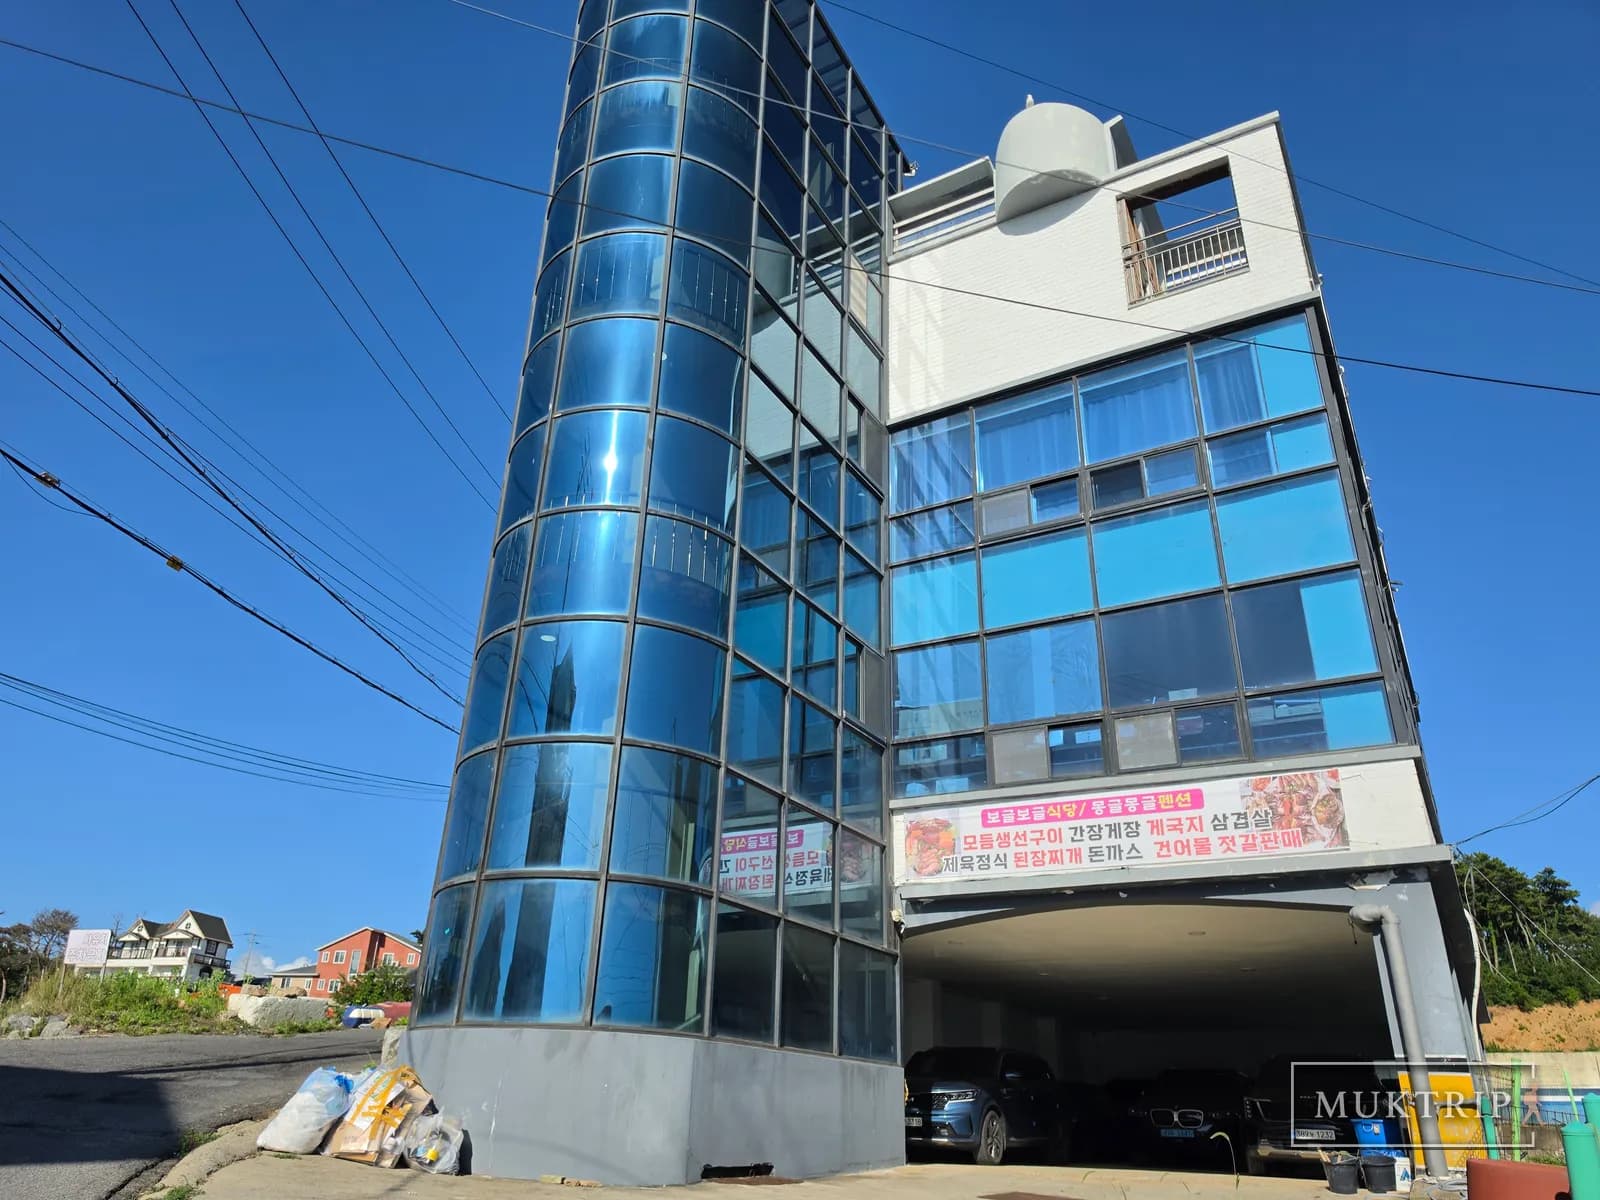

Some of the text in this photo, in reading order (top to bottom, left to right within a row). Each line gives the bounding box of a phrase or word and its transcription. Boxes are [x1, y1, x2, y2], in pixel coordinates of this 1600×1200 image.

[1091, 792, 1192, 814] 몽글몽글펜션
[943, 829, 1303, 873] 제육정식 된장찌개 돈까스 건어물 젓갈판매
[963, 809, 1273, 851] 모듬생선구이 간장게장 게국지 삼겹살
